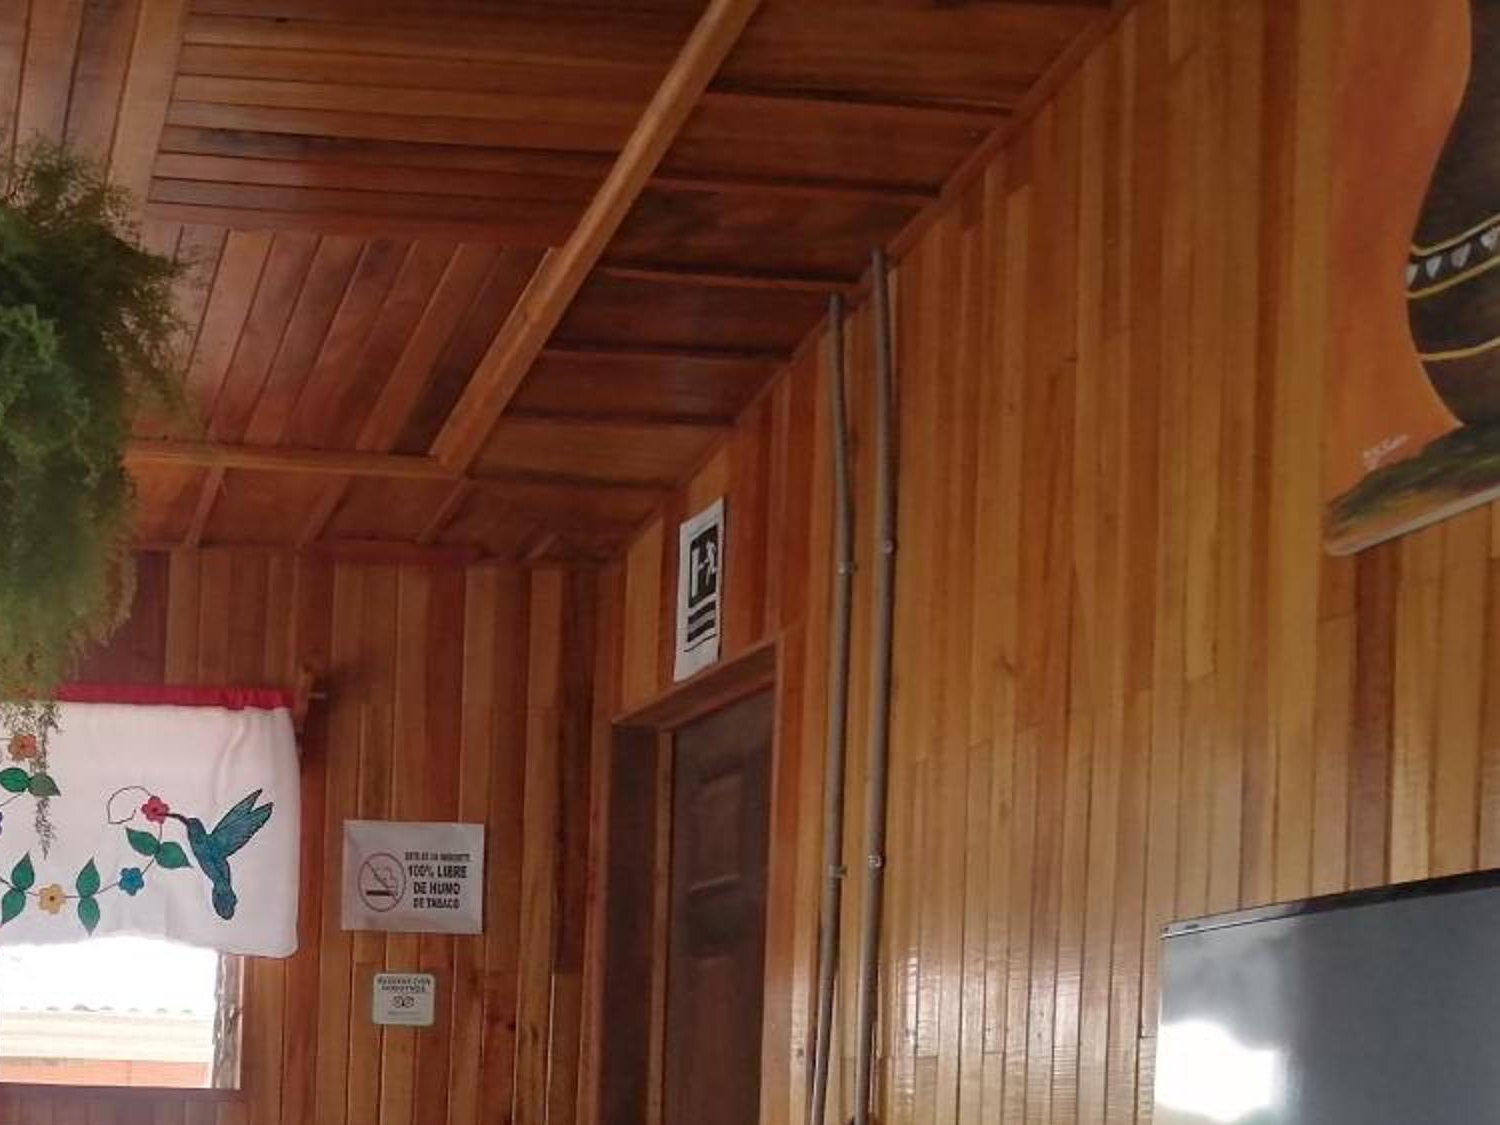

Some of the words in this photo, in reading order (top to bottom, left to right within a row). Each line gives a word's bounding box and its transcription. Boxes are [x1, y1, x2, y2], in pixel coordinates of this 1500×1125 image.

[408, 865, 435, 878] 100%
[437, 865, 467, 878] LIBRE
[413, 882, 427, 894] DE
[430, 882, 461, 895] HUMO
